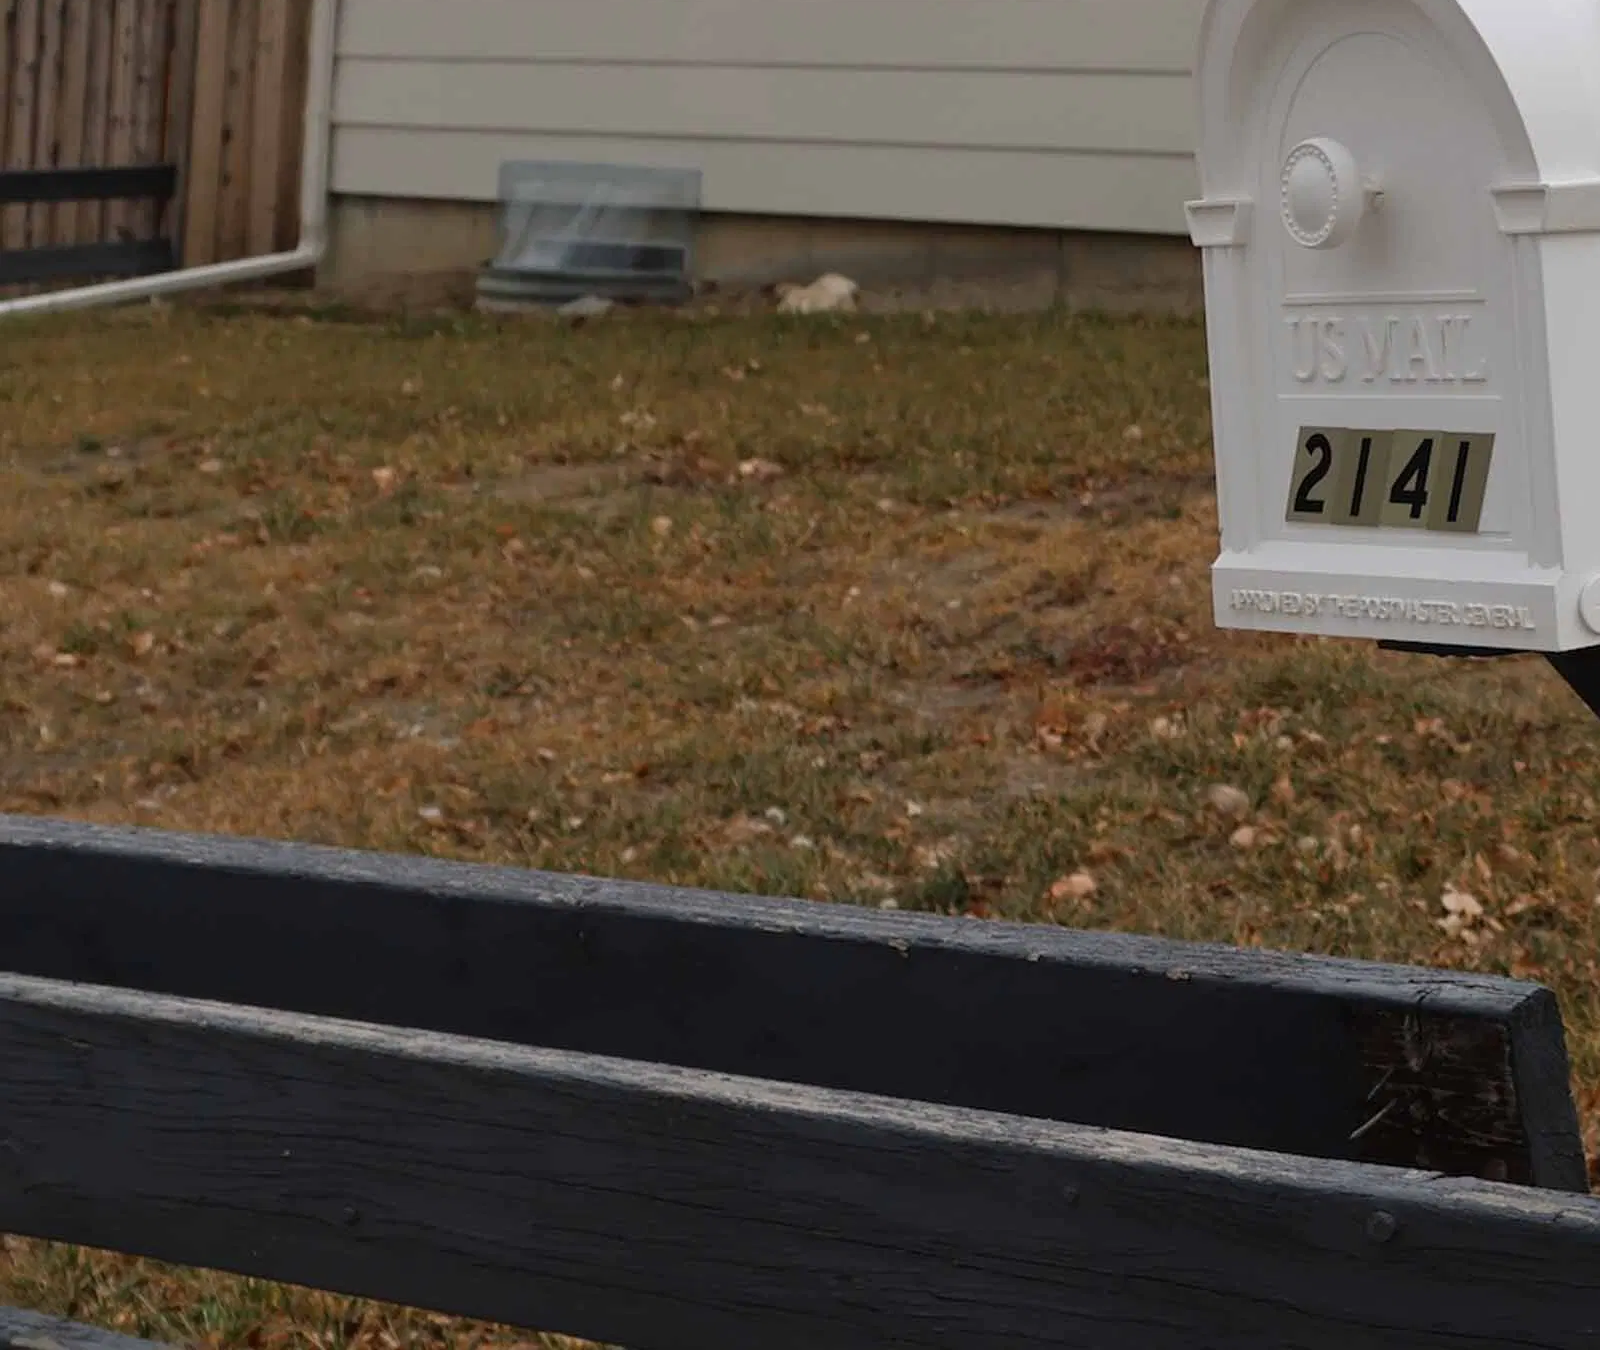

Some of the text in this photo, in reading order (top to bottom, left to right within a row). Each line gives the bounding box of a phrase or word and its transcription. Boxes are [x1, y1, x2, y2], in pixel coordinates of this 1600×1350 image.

[1283, 314, 1488, 383] US MAIL
[1294, 433, 1470, 522] 2141
